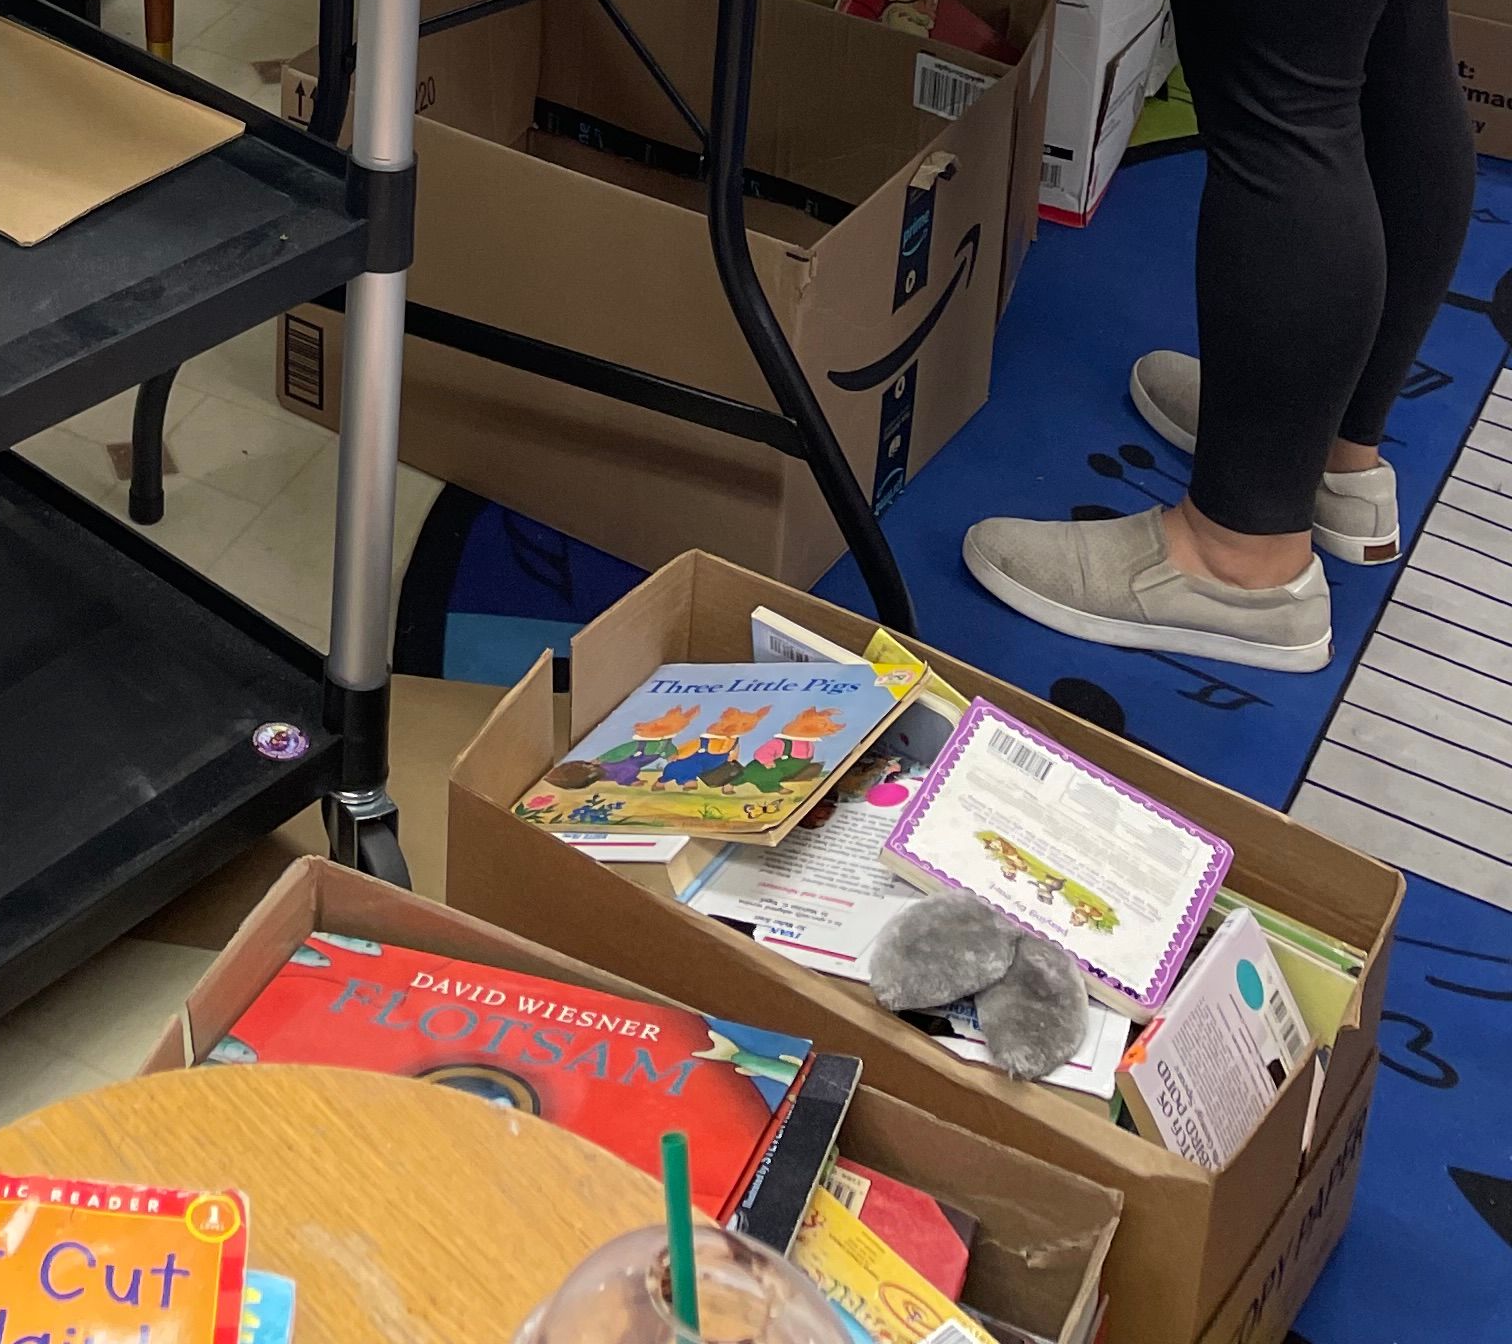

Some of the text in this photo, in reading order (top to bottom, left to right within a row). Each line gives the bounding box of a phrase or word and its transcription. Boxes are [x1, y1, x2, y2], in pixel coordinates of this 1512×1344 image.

[647, 678, 862, 698] Three Little Pigs
[769, 926, 803, 940] IVAN
[410, 971, 661, 1042] DAVID WIESNER
[328, 977, 701, 1097] FLOTSAM
[1153, 1058, 1189, 1115] POND
[1167, 1119, 1197, 1165] ITCH
[51, 1188, 162, 1214] READER
[209, 1204, 219, 1224] 1
[39, 1242, 191, 1310] Cut
